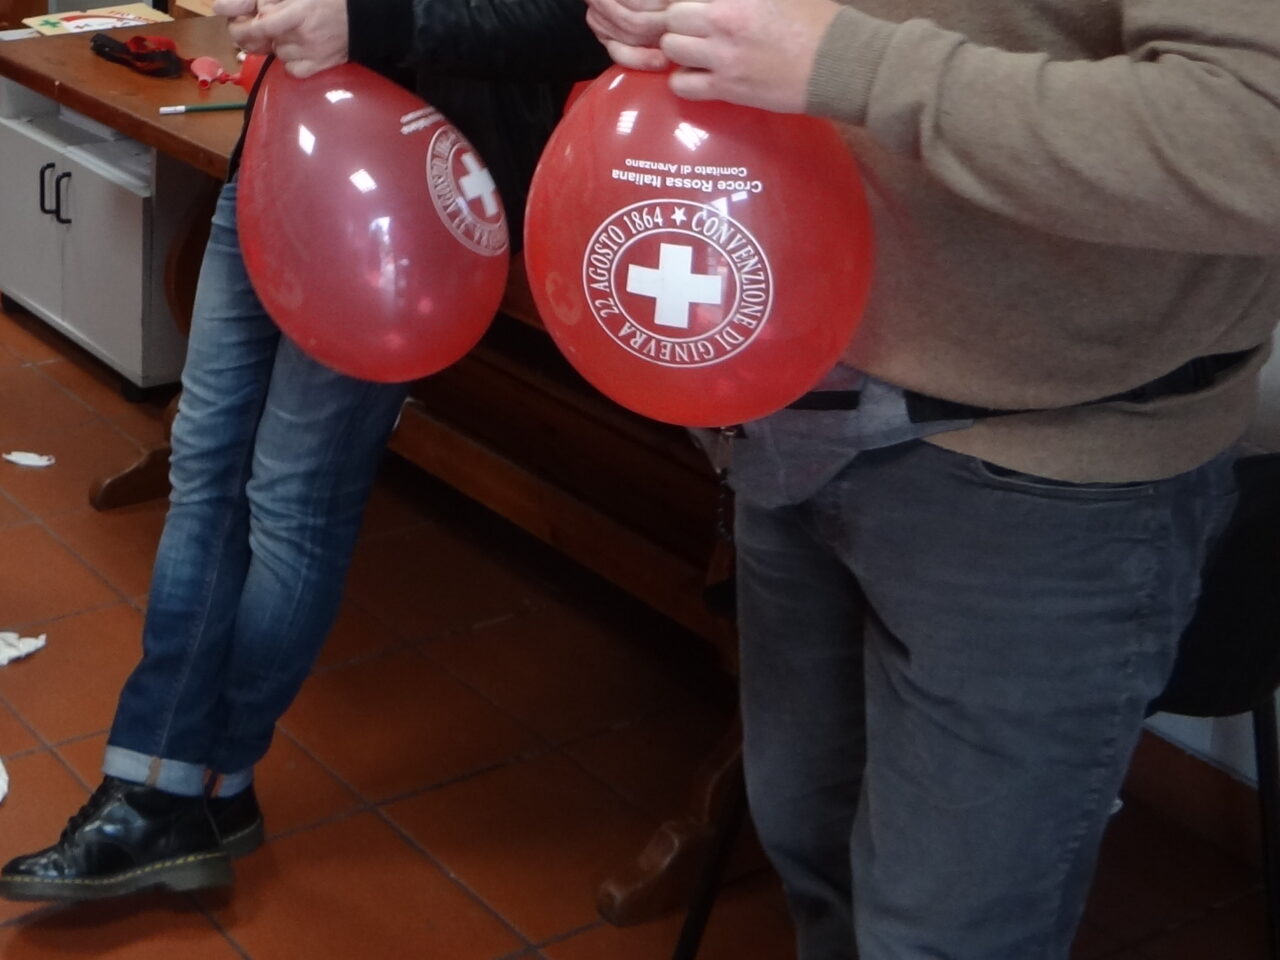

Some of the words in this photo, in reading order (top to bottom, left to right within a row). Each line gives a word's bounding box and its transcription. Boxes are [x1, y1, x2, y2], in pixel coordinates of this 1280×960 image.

[625, 158, 678, 174] Arenzano
[680, 165, 693, 175] di
[694, 166, 747, 177] Comitato
[611, 169, 661, 188] Italiana
[665, 177, 713, 192] Rossa
[717, 180, 762, 193] Croce
[623, 206, 664, 235] 1864
[589, 224, 627, 292] AGOSTO
[691, 211, 766, 329] CONVENZIONE
[594, 297, 620, 318] 22
[618, 321, 715, 362] GINEVRA
[714, 330, 745, 351] DI
